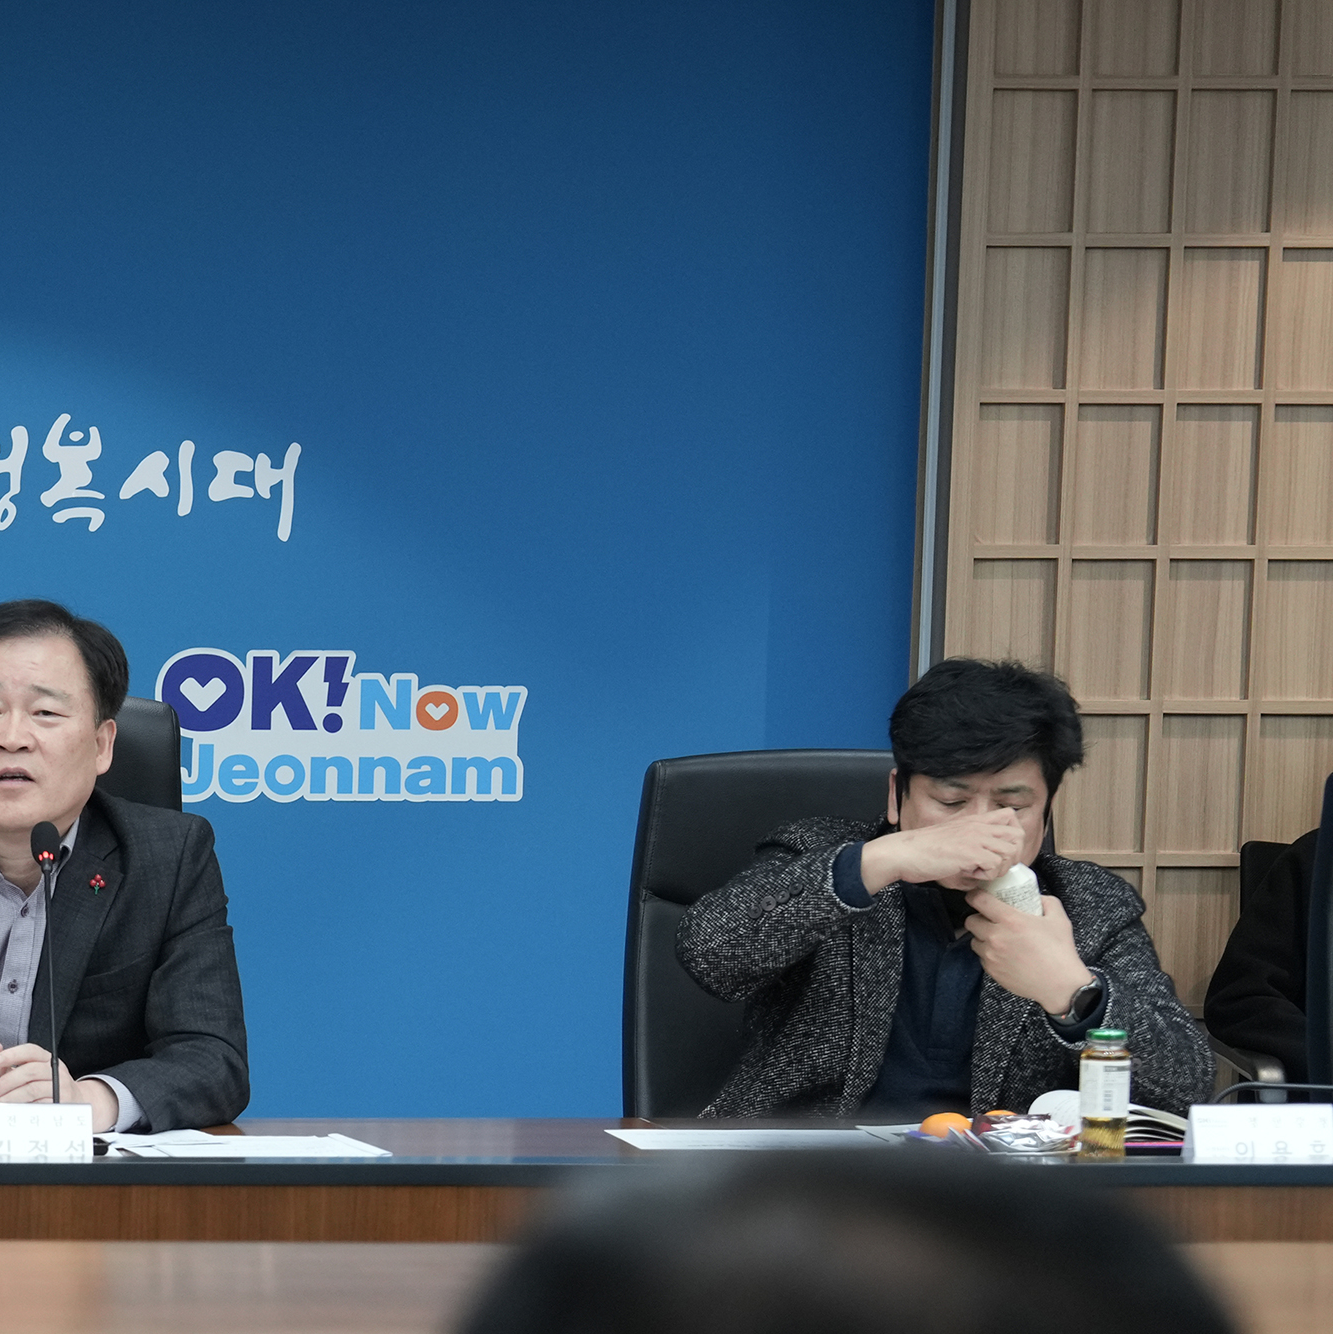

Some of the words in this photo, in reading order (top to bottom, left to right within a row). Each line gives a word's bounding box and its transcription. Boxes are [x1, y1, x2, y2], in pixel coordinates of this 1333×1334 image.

[161, 653, 350, 734] OK!
[358, 678, 521, 731] Now
[181, 743, 518, 796] Jeonnam
